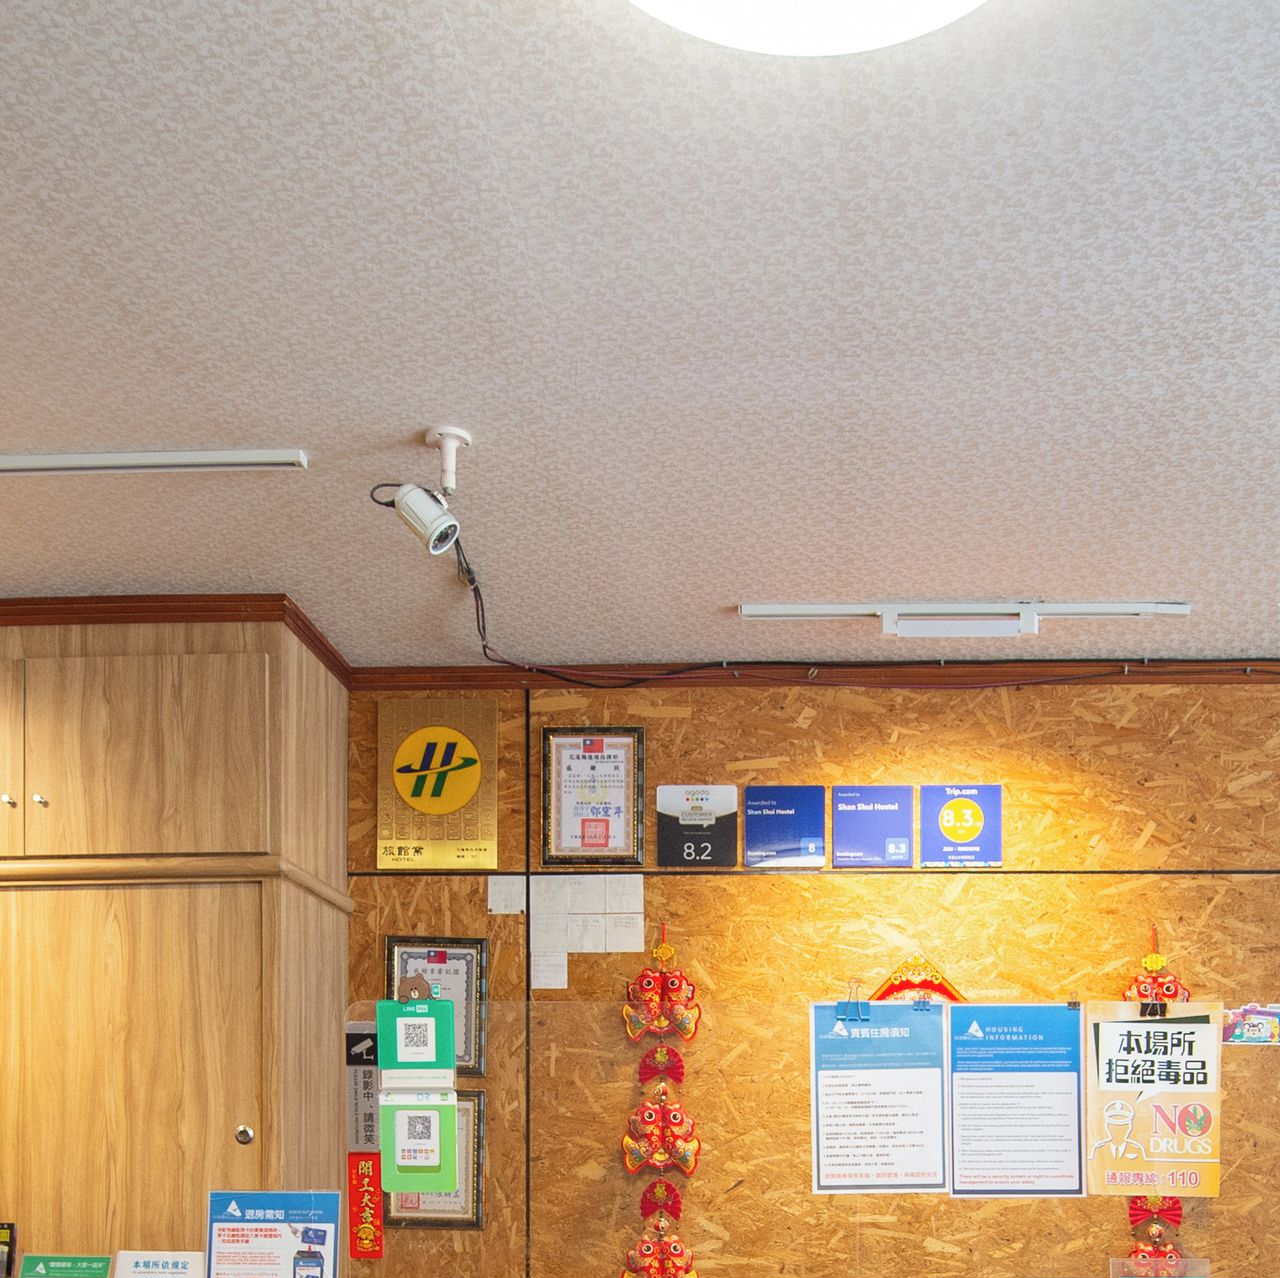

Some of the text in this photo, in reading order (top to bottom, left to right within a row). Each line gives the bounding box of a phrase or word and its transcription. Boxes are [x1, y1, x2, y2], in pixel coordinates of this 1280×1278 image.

[945, 787, 978, 796] Trip.com
[837, 803, 898, 811] Shan Shui Hostel
[942, 809, 974, 827] 8.3
[382, 846, 424, 856] 旅館業
[683, 843, 712, 860] 8.2
[808, 843, 816, 853] 8
[888, 843, 906, 853] 8.3
[1118, 1030, 1196, 1056] 本場所
[1105, 1058, 1208, 1085] 拒絕毒品
[1151, 1103, 1213, 1138] NO
[1149, 1137, 1212, 1154] DRUGS
[357, 1160, 376, 1223] 開工大吉
[132, 1260, 190, 1270] 本場所依規定
